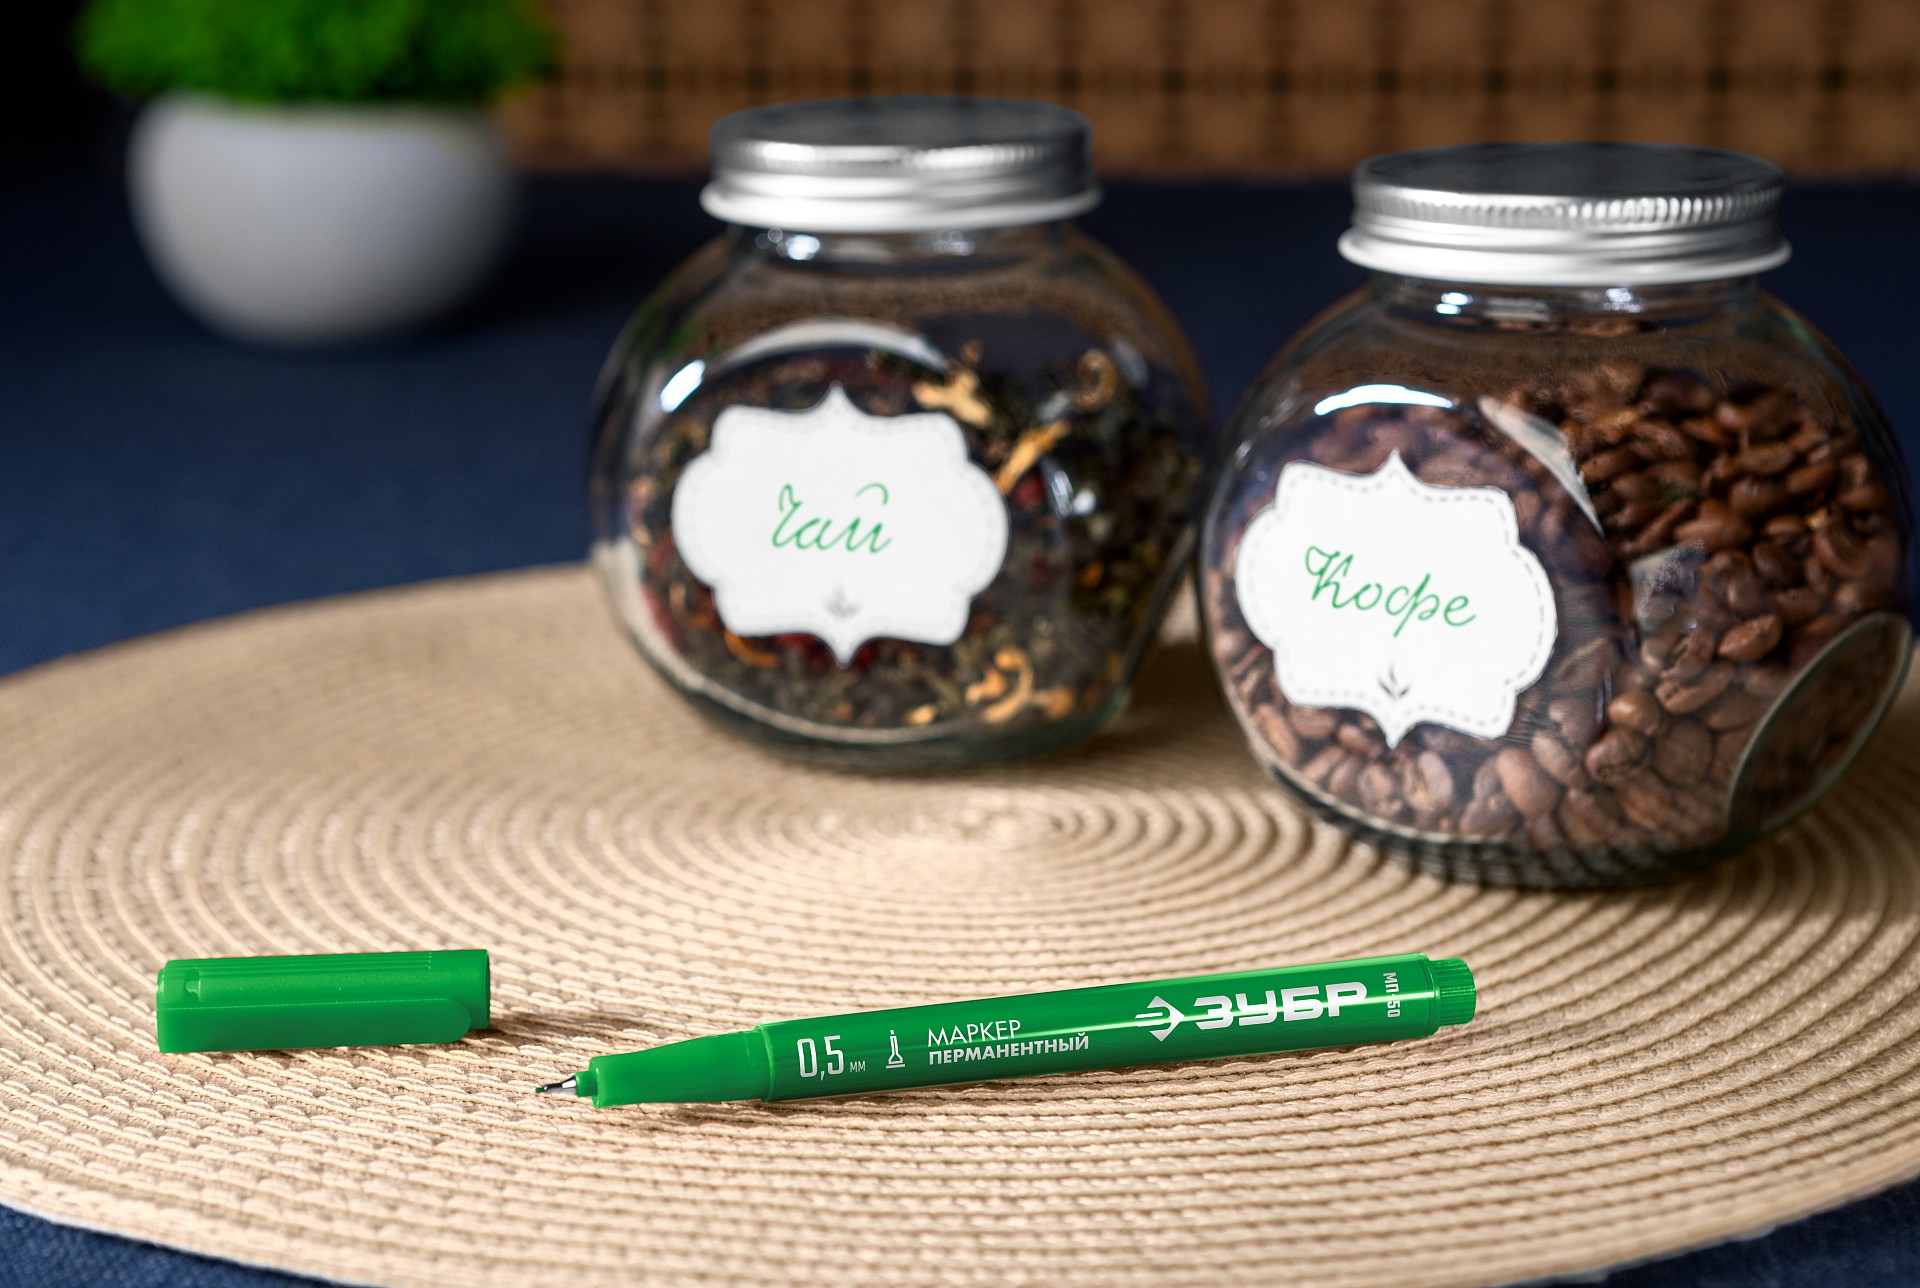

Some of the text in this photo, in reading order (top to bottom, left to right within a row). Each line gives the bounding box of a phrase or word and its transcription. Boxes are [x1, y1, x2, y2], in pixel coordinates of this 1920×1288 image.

[771, 482, 893, 554] Чай
[1304, 545, 1477, 638] Кофе
[1193, 981, 1368, 1030] ЗУБР
[1383, 972, 1400, 1018] МП-50
[927, 1019, 1021, 1047] МАРКЕР
[928, 1032, 1090, 1066] ПЕРМАНЕНТНЫЙ
[796, 1035, 844, 1082] 0,5
